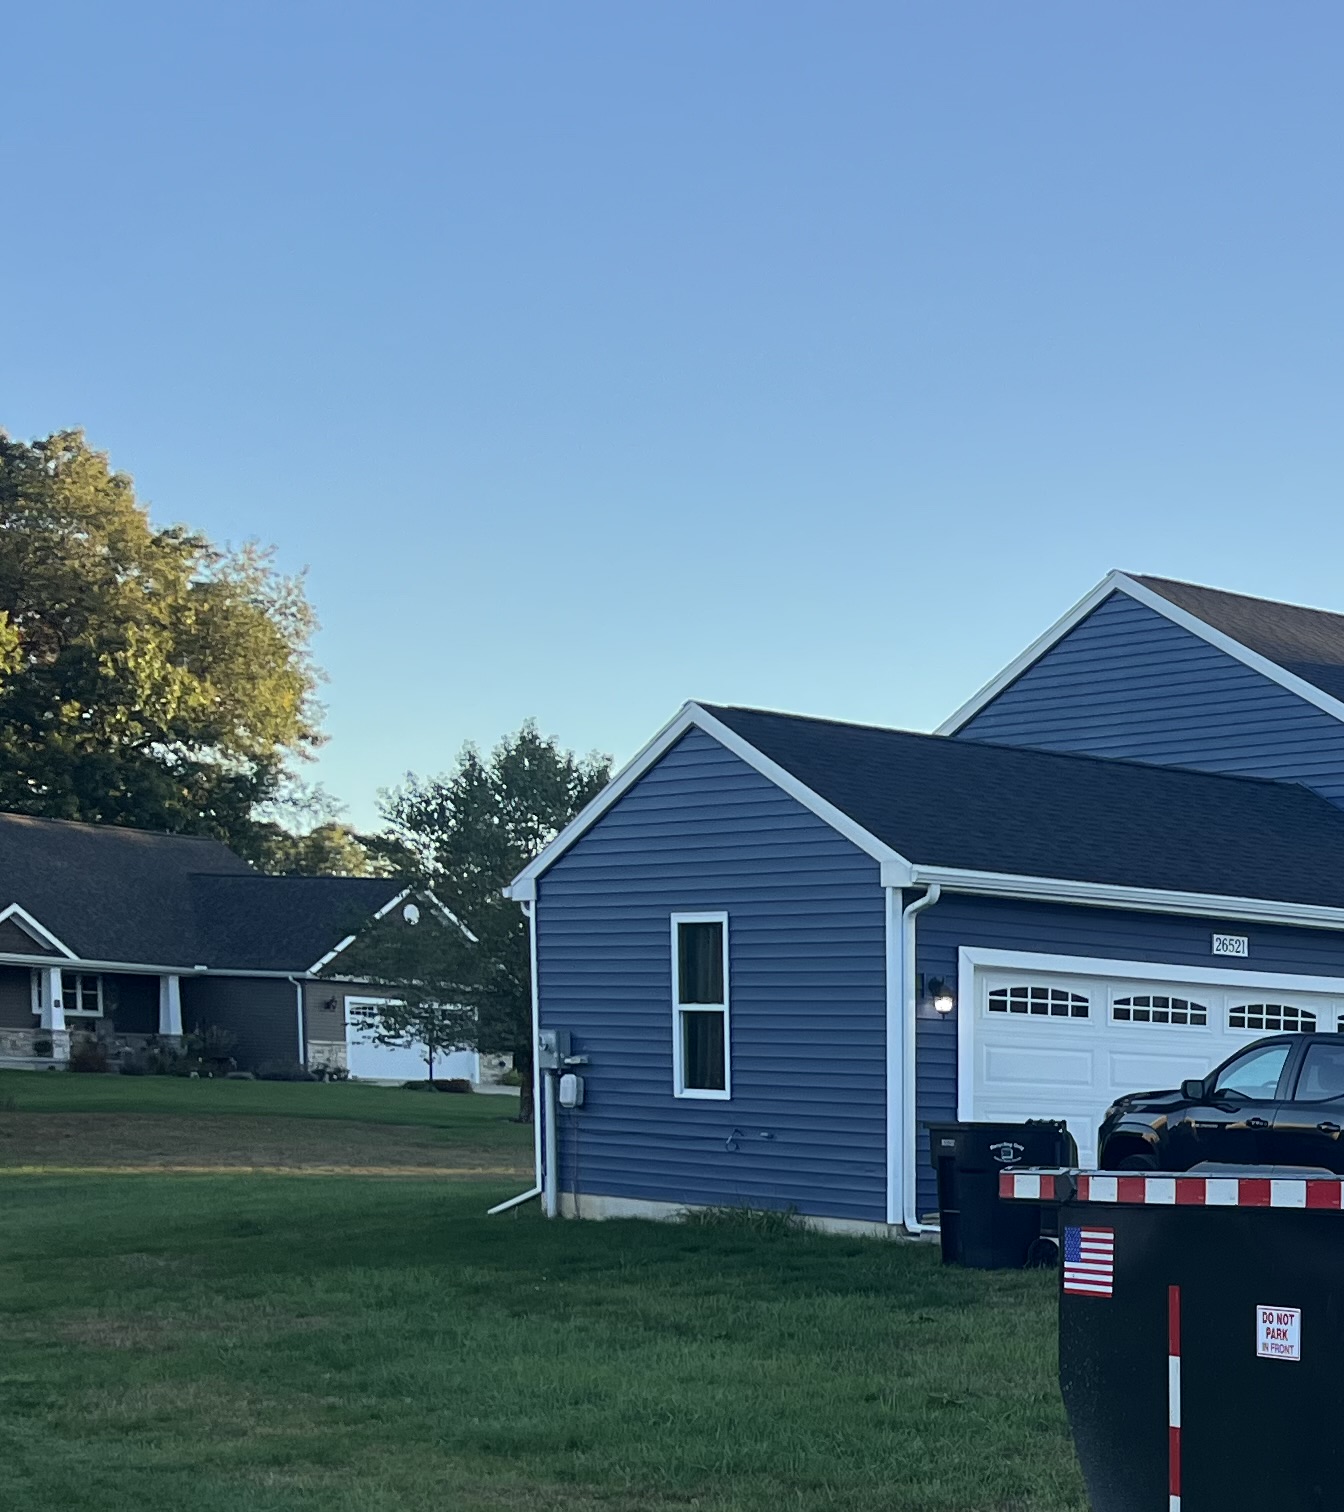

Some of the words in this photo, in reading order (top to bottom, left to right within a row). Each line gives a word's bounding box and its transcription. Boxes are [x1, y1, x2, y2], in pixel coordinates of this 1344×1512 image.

[1216, 937, 1246, 954] 26521
[1262, 1311, 1273, 1324] DO
[1277, 1313, 1294, 1326] NOT
[1266, 1327, 1288, 1341] PARK
[1262, 1342, 1269, 1352] IN
[1271, 1343, 1294, 1355] FRONT
